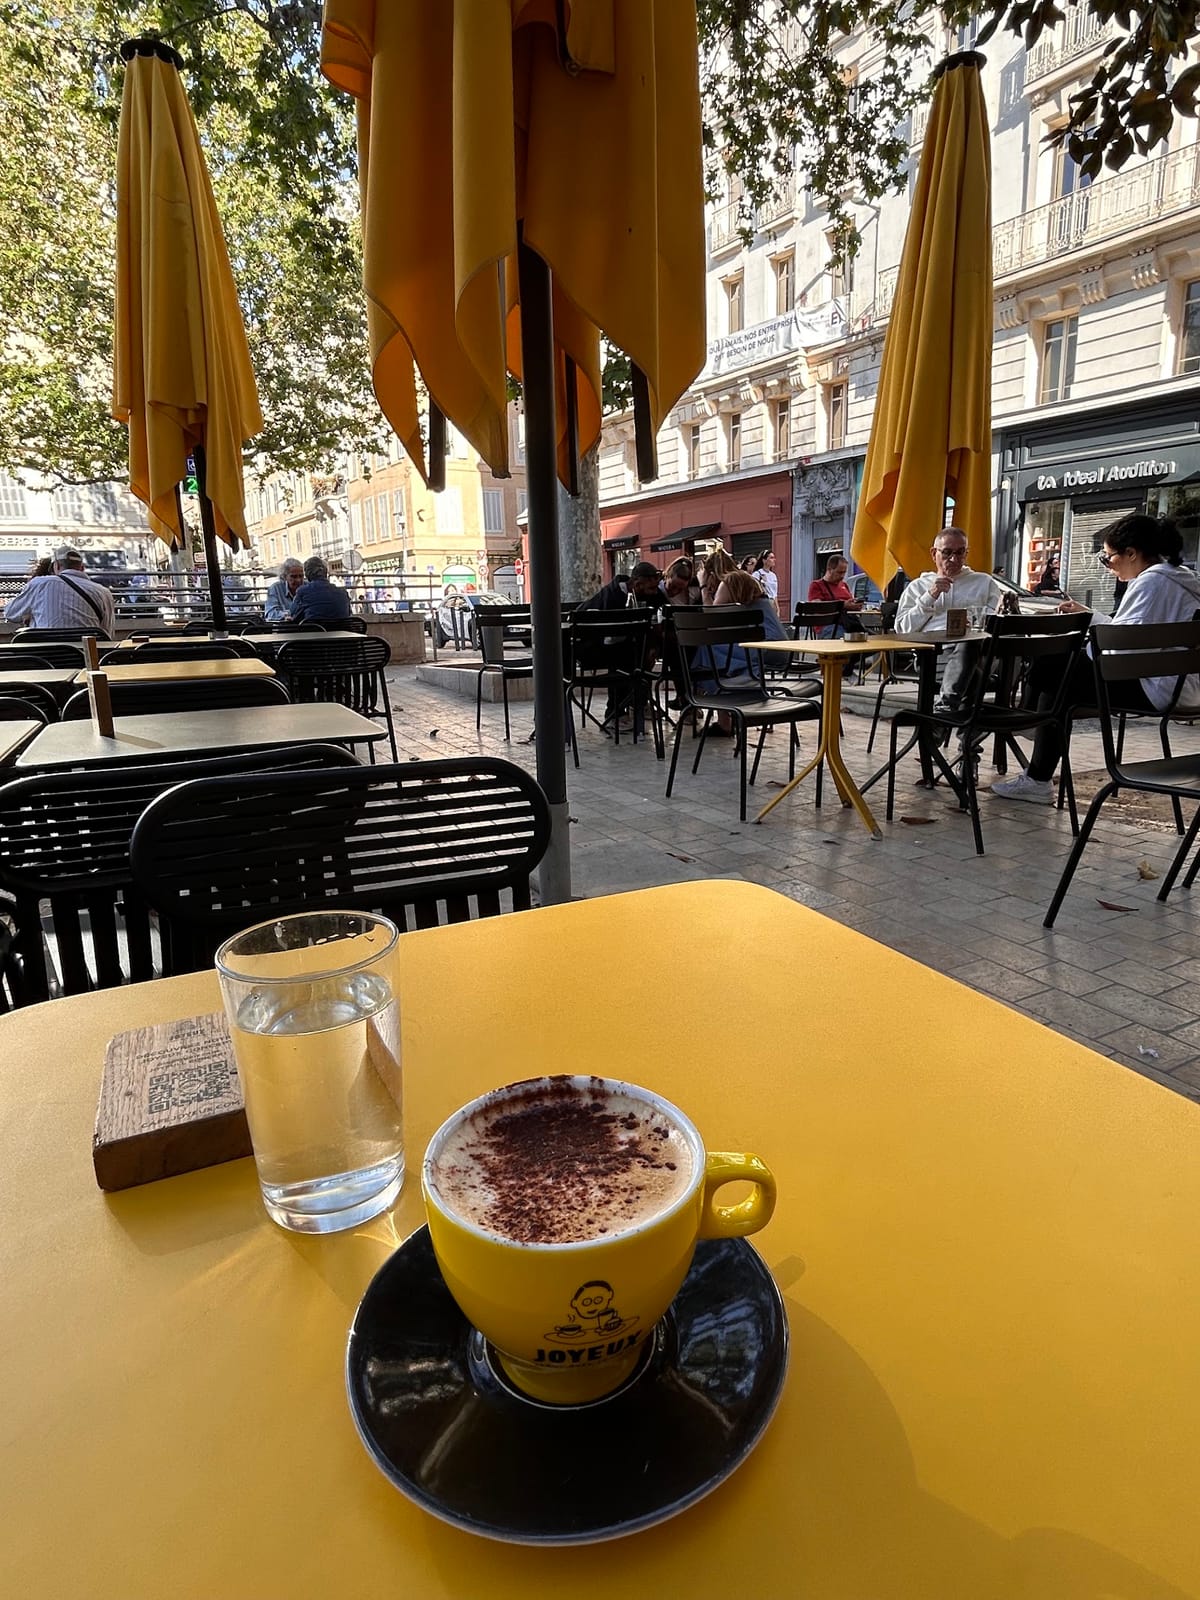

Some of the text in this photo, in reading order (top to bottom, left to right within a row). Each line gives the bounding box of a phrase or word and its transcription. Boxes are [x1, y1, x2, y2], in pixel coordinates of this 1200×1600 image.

[727, 345, 747, 358] BESOIN
[748, 341, 756, 350] DE
[757, 334, 775, 347] NOUS
[744, 331, 757, 342] NOS
[1063, 467, 1104, 488] Ideal
[1106, 459, 1176, 482] Audition
[169, 1028, 206, 1041] JOYEUX
[533, 1329, 643, 1363] JOYEUX
